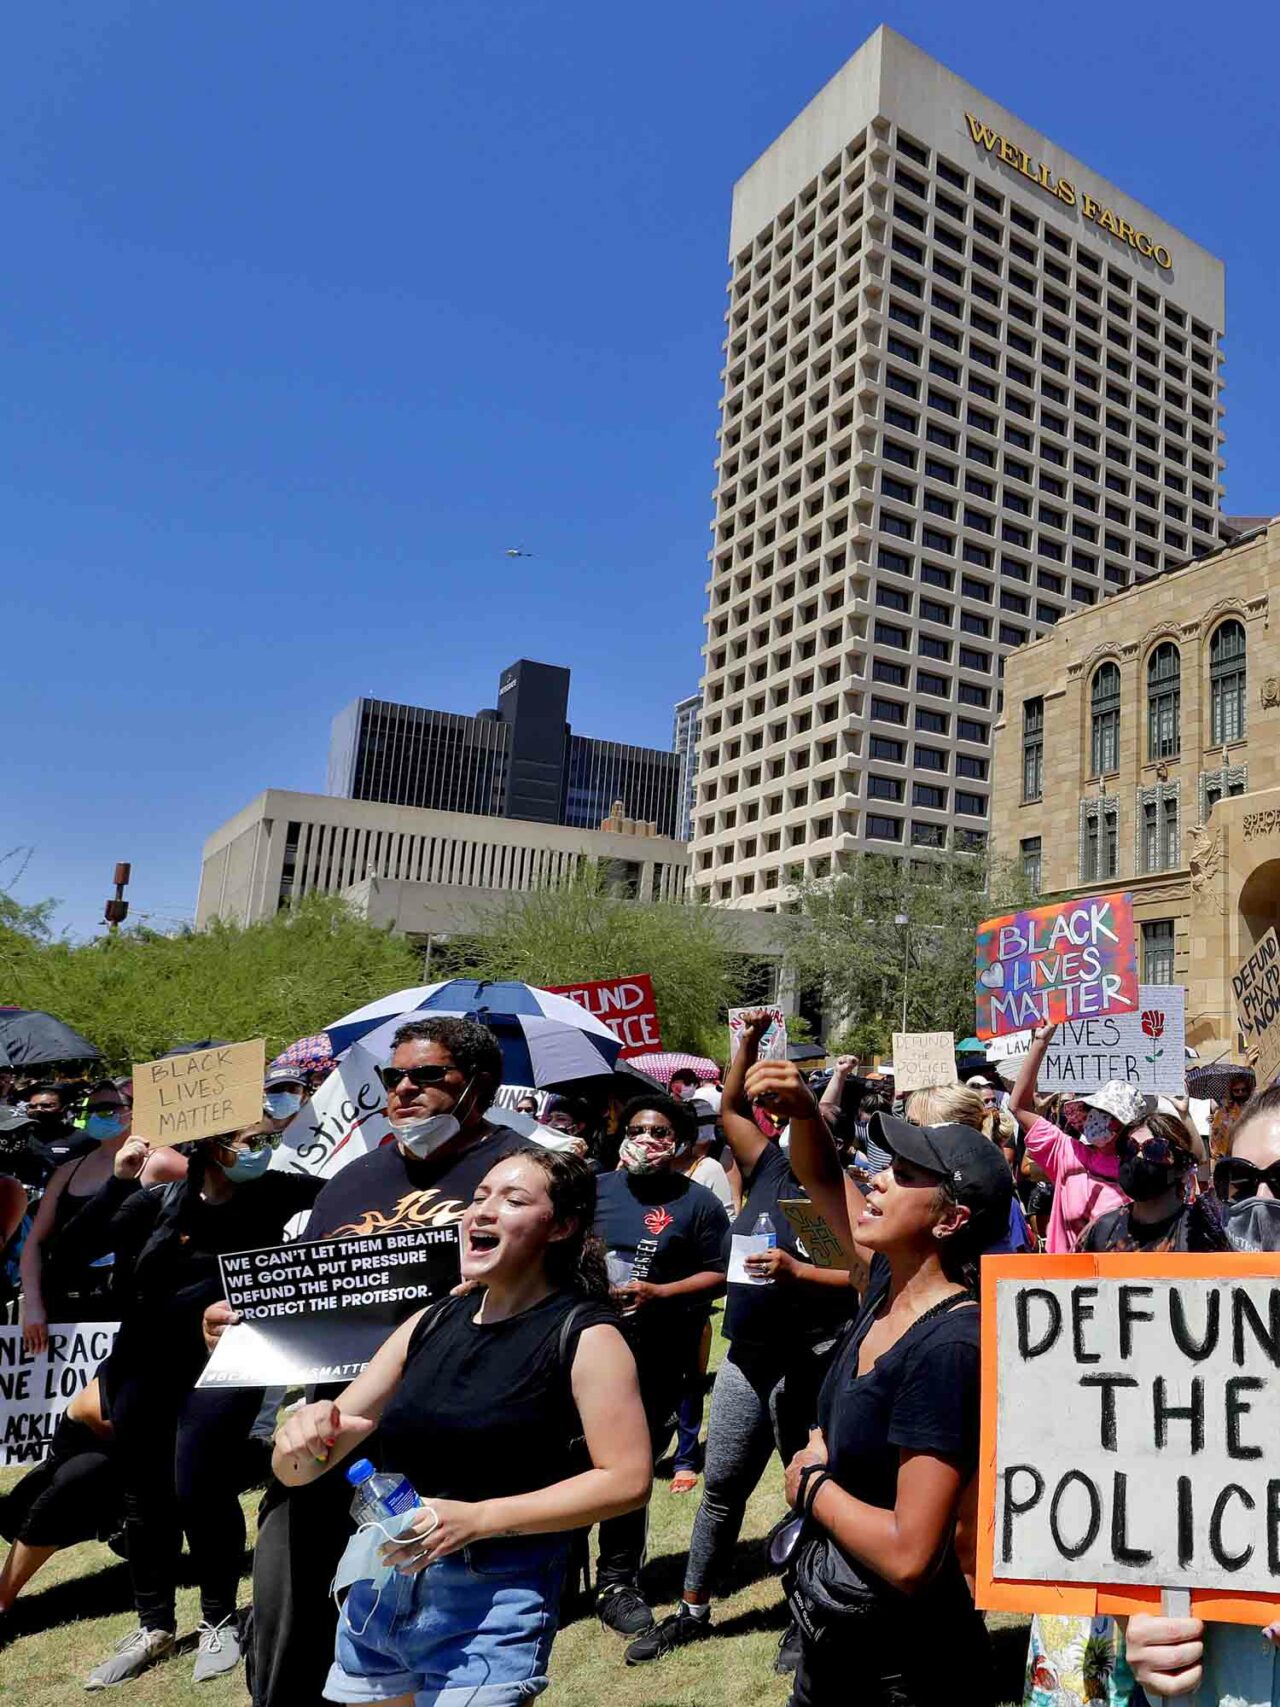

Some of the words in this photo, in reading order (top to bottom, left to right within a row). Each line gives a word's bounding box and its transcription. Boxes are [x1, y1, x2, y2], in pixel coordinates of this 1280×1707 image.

[965, 112, 1076, 206] WELLS
[1081, 192, 1172, 269] FARGO
[999, 903, 1120, 961] BLACK
[1013, 947, 1101, 991] LIVES
[1232, 936, 1277, 999] DEFUND
[560, 983, 644, 1015] FUND
[990, 974, 1133, 1034] MATTER
[896, 1035, 950, 1049] DEFUND
[1006, 1038, 1031, 1055] LAW
[151, 1049, 233, 1083] BLACK
[896, 1061, 950, 1074] POLICE
[1046, 1054, 1141, 1082] MATTER
[159, 1073, 225, 1107] LIVES
[159, 1099, 234, 1137] MATTER
[224, 1258, 250, 1272] WE
[254, 1248, 306, 1268] CAN'T
[311, 1244, 335, 1260] LET
[338, 1238, 383, 1256] THEM
[386, 1229, 458, 1250] BREATHE,
[227, 1273, 253, 1288] WE
[257, 1266, 314, 1284] GOTTA
[318, 1261, 346, 1276] PUT
[351, 1249, 427, 1272] PRESSURE
[231, 1285, 295, 1305] DEFUND
[298, 1280, 329, 1295] THE
[332, 1272, 389, 1291] POLICE
[235, 1300, 305, 1321] PROTECT
[308, 1296, 338, 1310] THE
[341, 1285, 432, 1308] PROTESTOR.
[48, 1331, 119, 1364] RAC
[1077, 1371, 1268, 1460] THE
[6, 1442, 54, 1465] MAT
